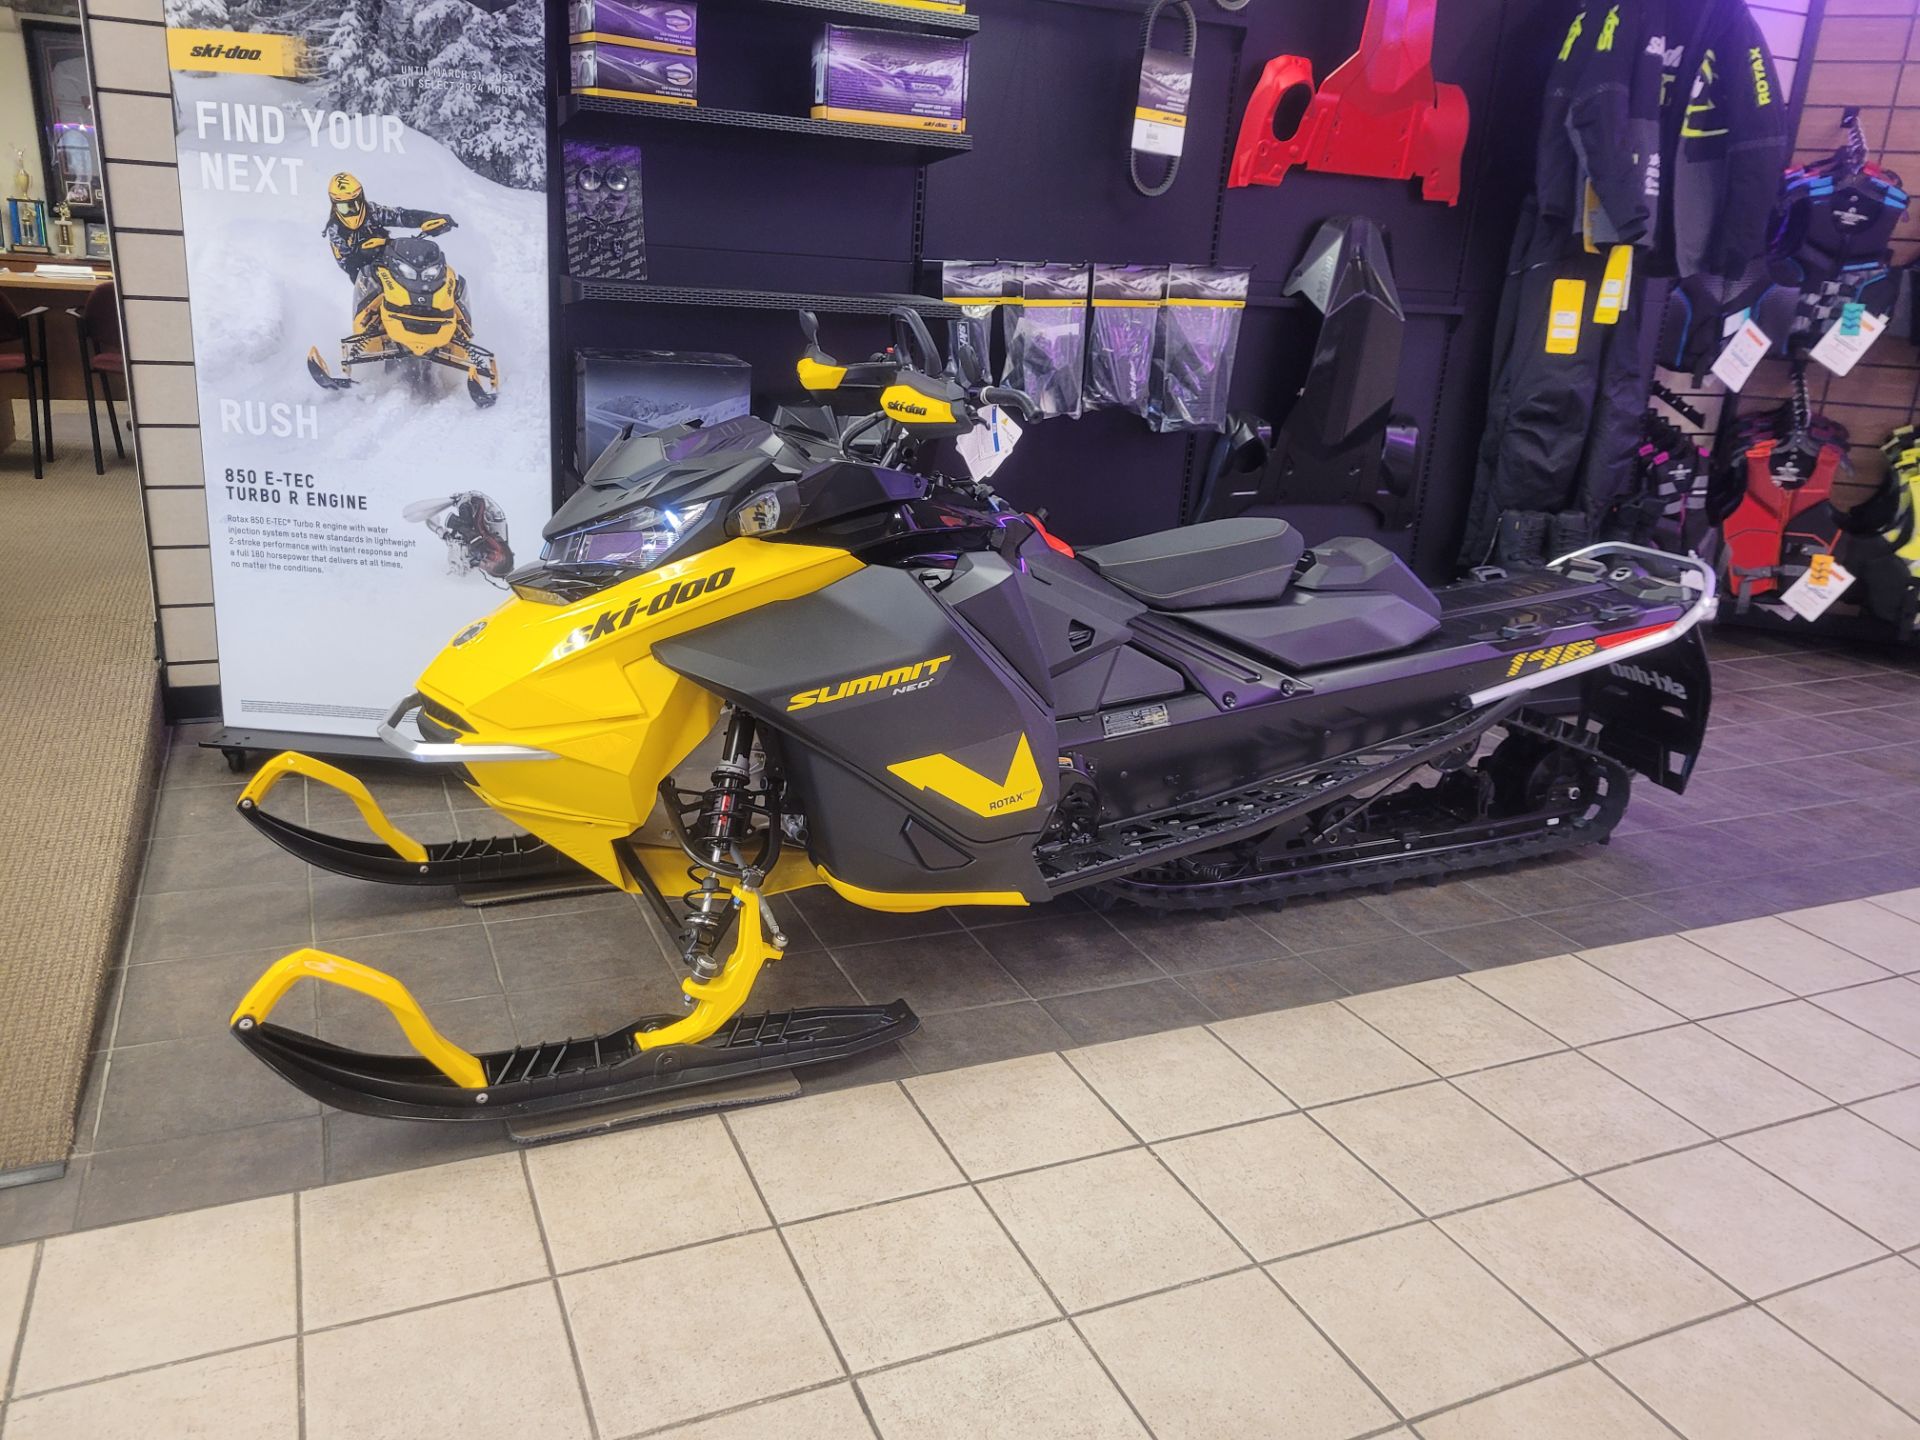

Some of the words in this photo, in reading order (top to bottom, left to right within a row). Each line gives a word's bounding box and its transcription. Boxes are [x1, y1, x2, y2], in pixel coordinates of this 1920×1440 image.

[190, 44, 261, 60] ski-doo
[401, 65, 428, 76] UNTIL
[433, 67, 467, 79] MARCH
[1750, 47, 1771, 106] ROTAX
[402, 78, 414, 88] ON
[418, 79, 455, 90] SELECT
[459, 83, 484, 93] 2024
[196, 101, 285, 145] FIND
[301, 108, 406, 154] YOUR
[200, 151, 304, 196] NEXT
[888, 400, 927, 416] ski-doo
[219, 398, 319, 440] RUSH
[225, 468, 257, 485] 850
[265, 471, 315, 489] E-TEC
[225, 486, 281, 504] TURBO
[289, 490, 299, 505] R
[306, 492, 368, 510] ENGINE
[227, 514, 249, 523] Rotax
[250, 516, 264, 524] 850
[293, 519, 314, 528] Turbo
[315, 521, 320, 529] R
[322, 522, 347, 531] engine
[349, 524, 365, 532] with
[367, 526, 388, 534] water
[228, 526, 260, 535] injection
[262, 529, 289, 537] system
[291, 531, 307, 539] sets
[326, 533, 364, 543] standards
[374, 537, 416, 548] lightweight
[229, 537, 260, 546] 2-stroke
[262, 540, 309, 550] performance
[329, 545, 355, 553] instant
[357, 548, 392, 556] response
[393, 550, 408, 558] and
[236, 549, 249, 557] full
[251, 550, 264, 558] 180
[266, 551, 309, 561] horsepower
[311, 555, 327, 563] that
[328, 555, 358, 565] delivers
[360, 558, 367, 566] at
[369, 559, 379, 567] all
[242, 561, 267, 570] matter
[269, 562, 281, 570] the
[283, 564, 324, 573] conditions.
[564, 567, 735, 652] ski-doo
[1506, 640, 1597, 677] 146
[786, 655, 951, 712] SUMMIT
[989, 793, 1023, 810] ROTAX
